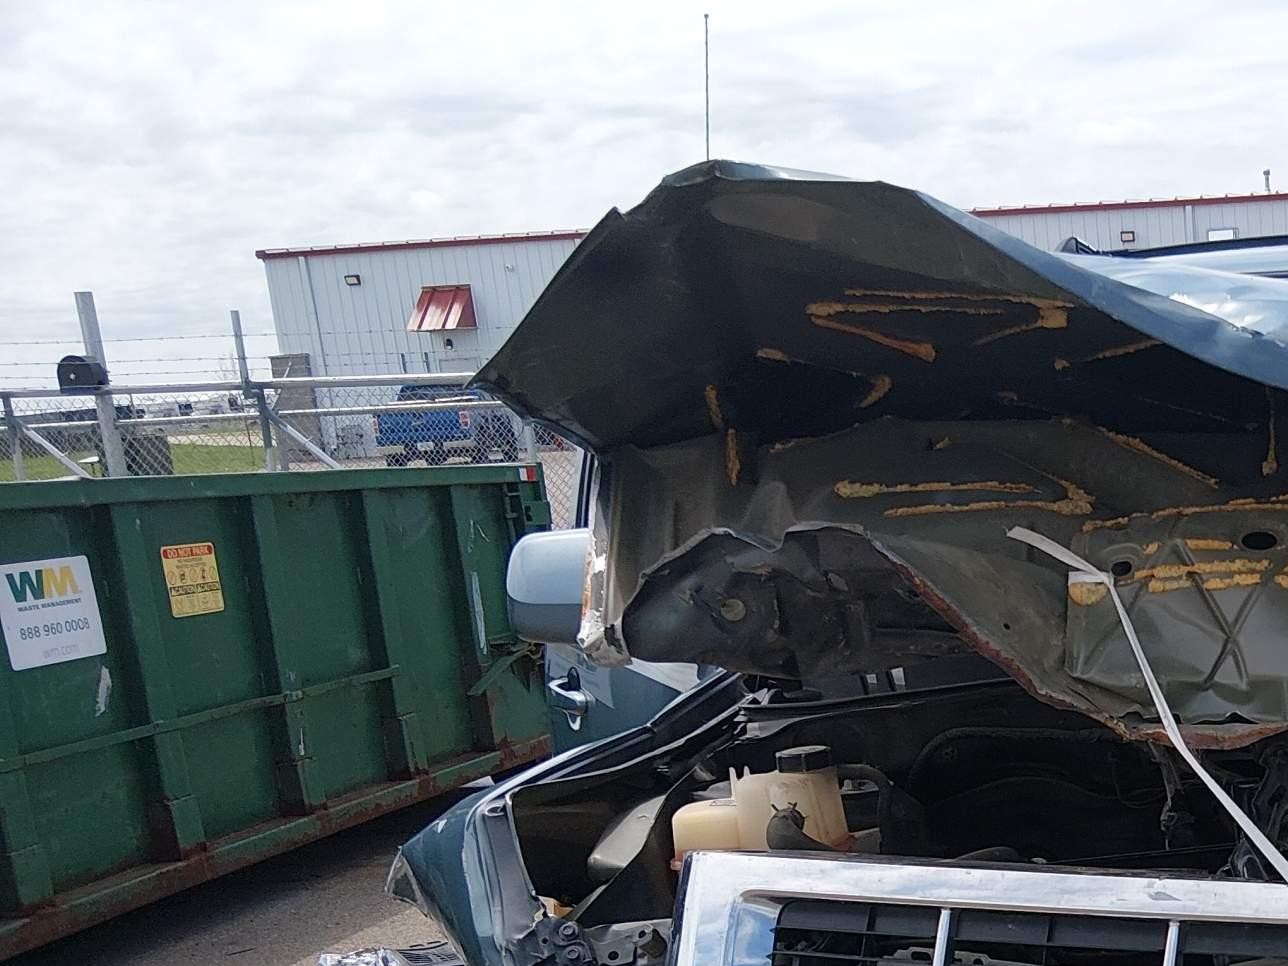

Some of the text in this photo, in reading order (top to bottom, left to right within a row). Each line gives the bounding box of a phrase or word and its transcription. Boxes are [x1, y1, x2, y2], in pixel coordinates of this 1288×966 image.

[5, 565, 80, 603] WM
[17, 597, 82, 612] WASTE MANAGEMENT
[20, 617, 90, 641] 888 960 0008
